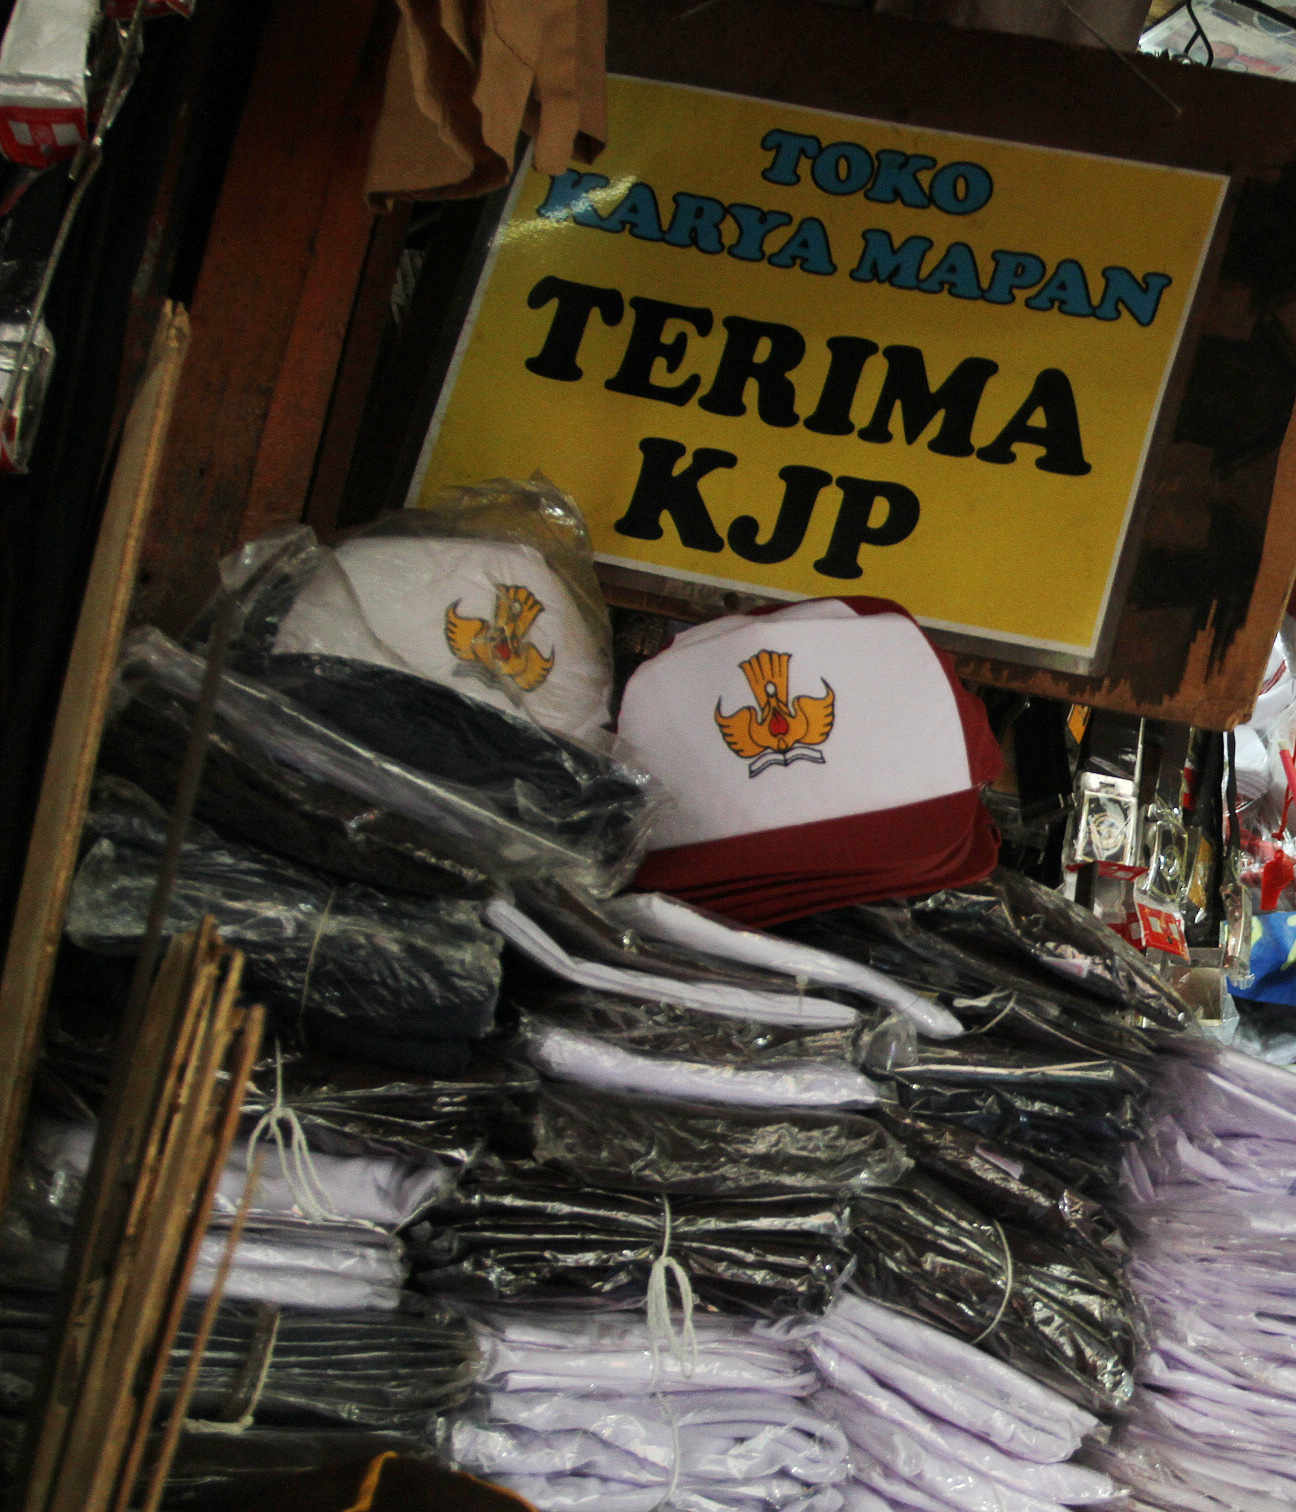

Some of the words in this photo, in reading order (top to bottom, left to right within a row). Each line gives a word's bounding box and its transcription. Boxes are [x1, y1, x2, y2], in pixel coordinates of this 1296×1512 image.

[536, 168, 837, 276] KARYA
[849, 228, 1172, 326] MAPAN
[760, 128, 994, 215] TOKO
[524, 275, 1093, 477] TERIMA
[613, 436, 921, 580] KJP
